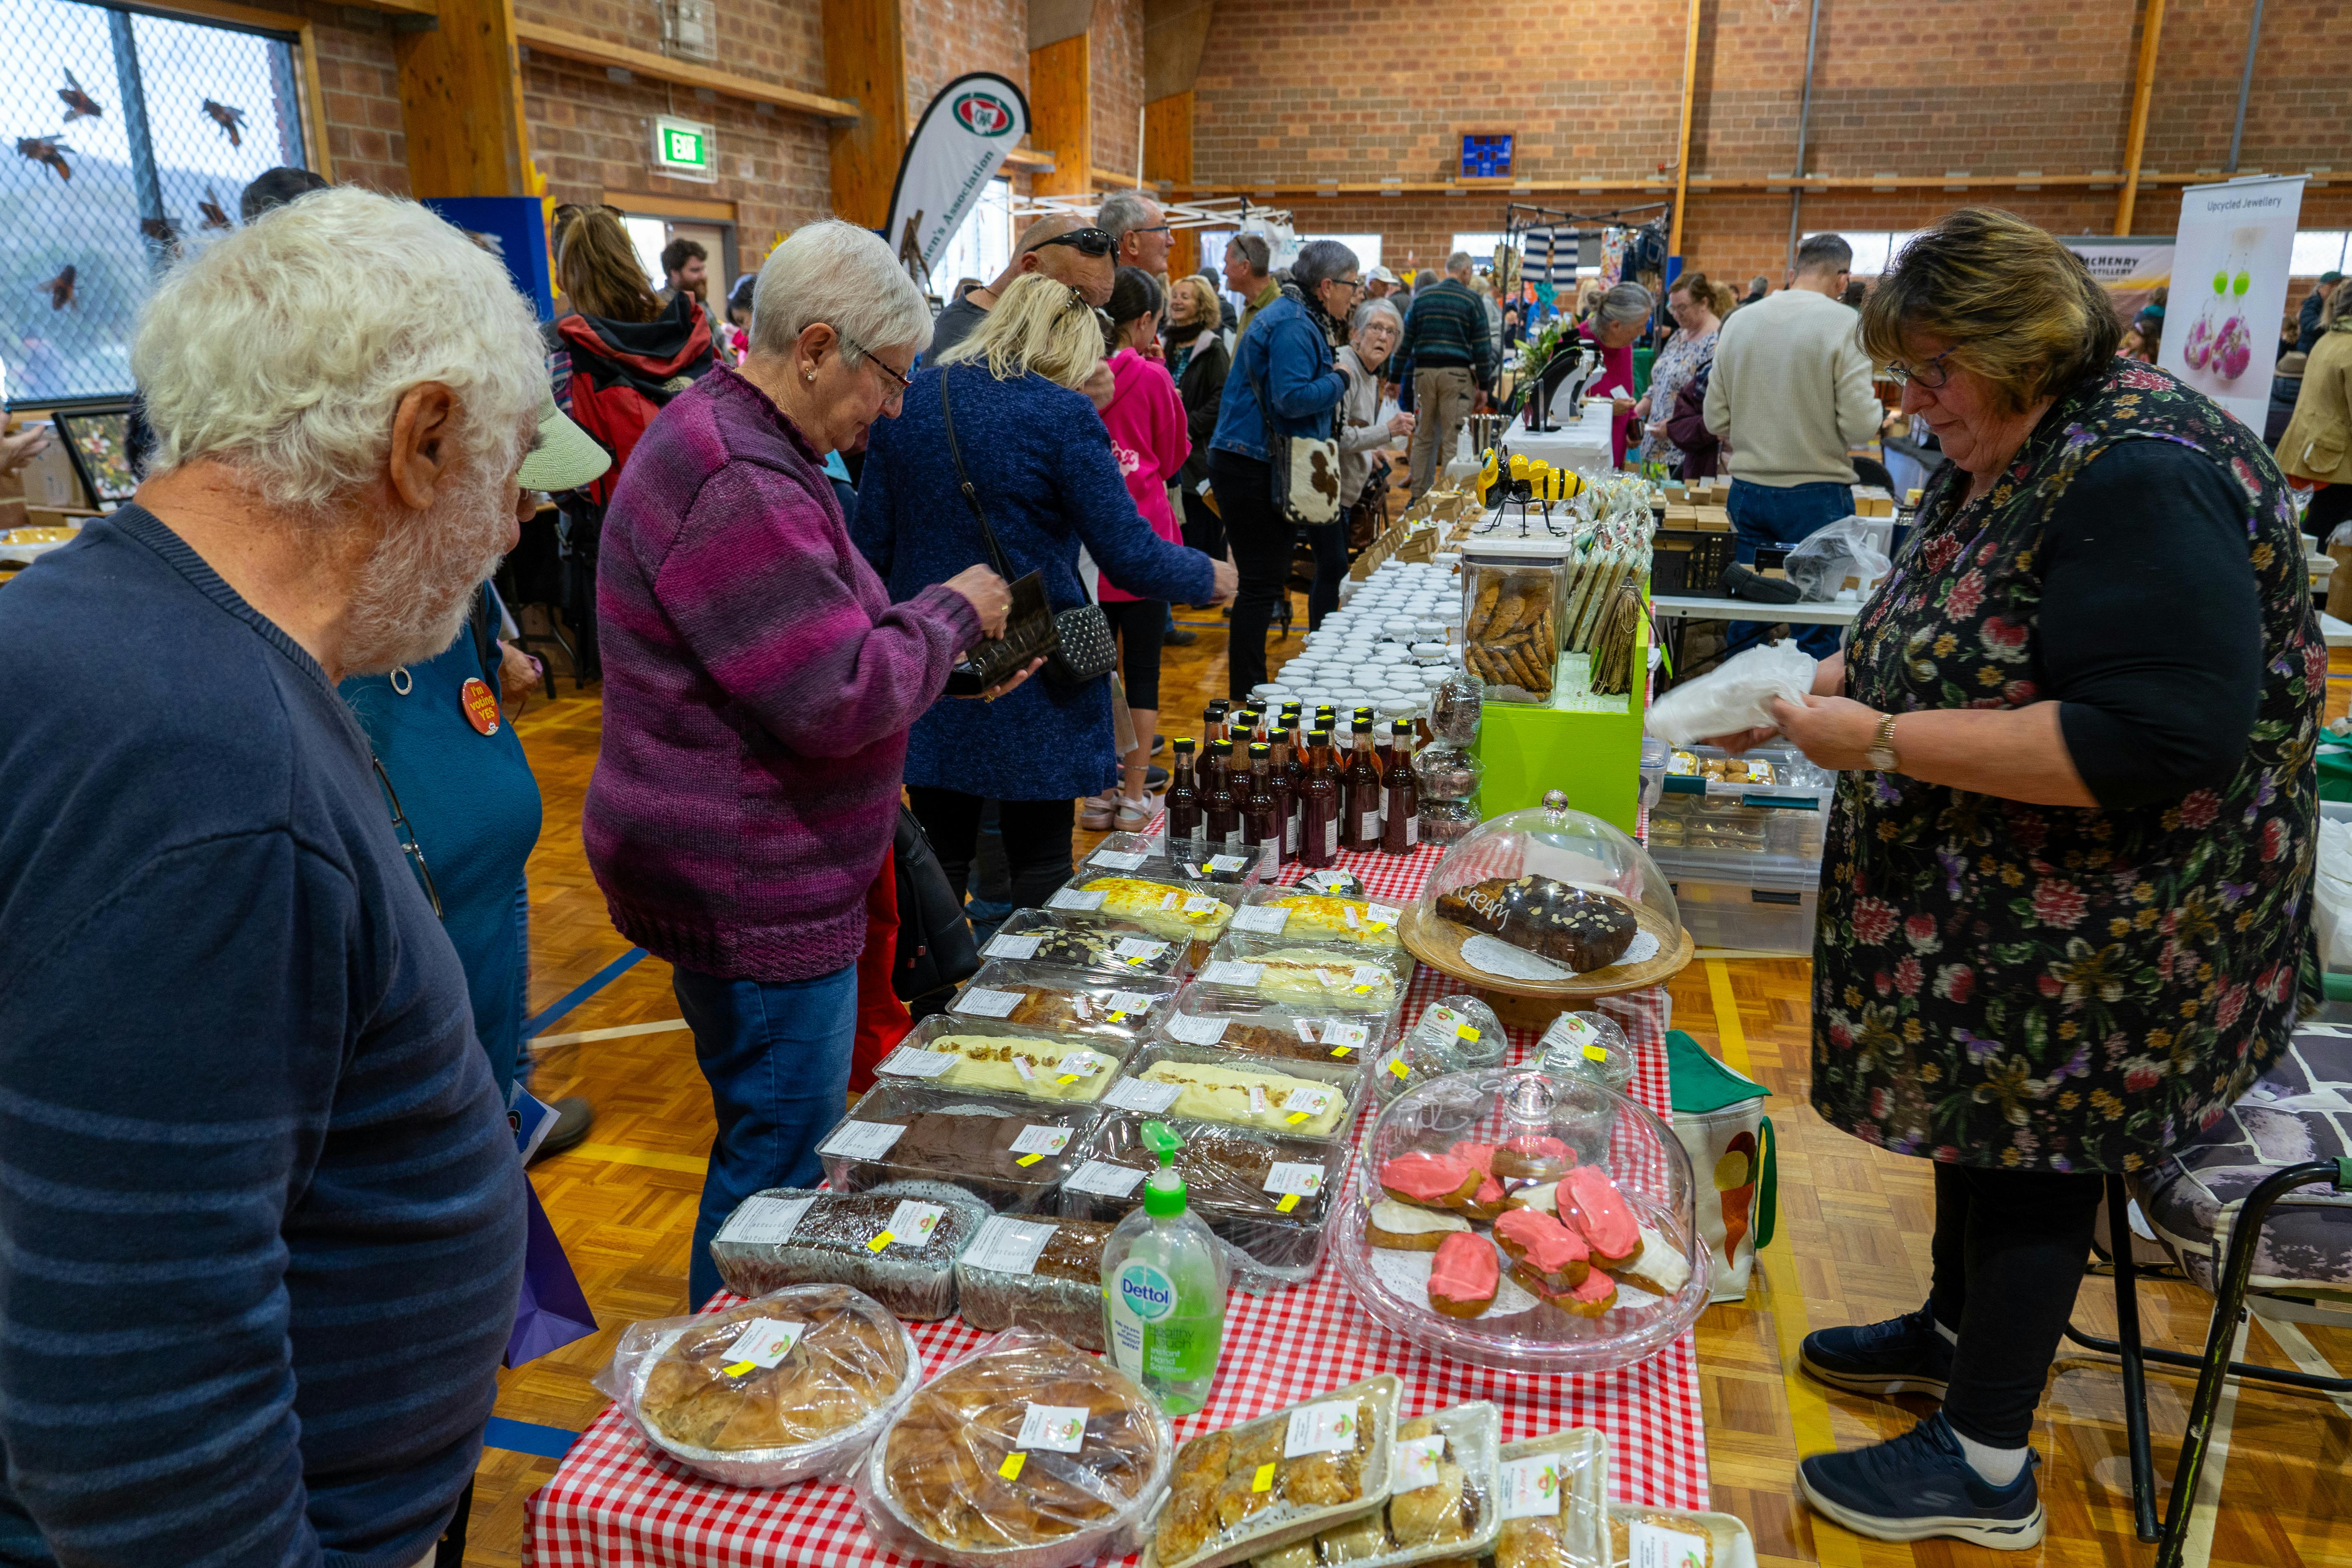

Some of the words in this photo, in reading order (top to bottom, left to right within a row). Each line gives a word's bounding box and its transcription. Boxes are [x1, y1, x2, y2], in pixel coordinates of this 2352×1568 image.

[671, 132, 696, 161] EXIT
[942, 150, 994, 226] Association
[2207, 198, 2241, 213] Upcycled
[2242, 196, 2282, 208] Jewellery
[470, 685, 484, 697] I'm
[469, 695, 495, 711] voting
[478, 707, 495, 721] YES
[1589, 1047, 1603, 1056] 10-00
[1123, 1278, 1169, 1304] Dettol
[1117, 1331, 1140, 1345] WITHOUT
[1148, 1323, 1195, 1339] Healthy
[1122, 1340, 1139, 1351] WATER
[1151, 1347, 1180, 1358] Instant
[1150, 1356, 1175, 1365] Hand
